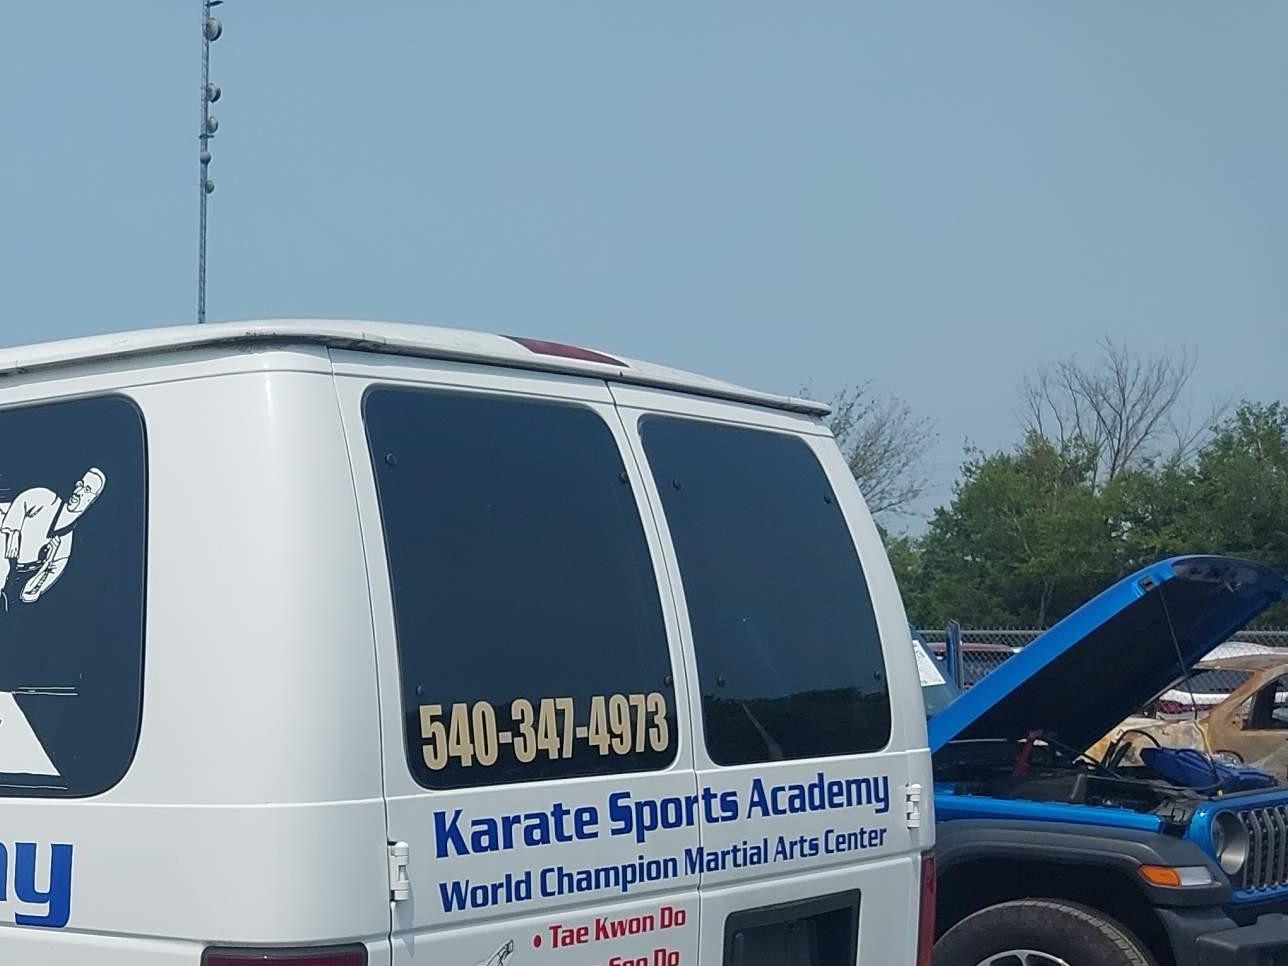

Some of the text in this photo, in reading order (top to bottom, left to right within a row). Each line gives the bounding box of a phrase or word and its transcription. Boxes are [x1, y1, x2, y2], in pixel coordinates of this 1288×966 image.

[418, 692, 669, 771] 540-347-4973
[433, 772, 890, 859] Karate Sports Academy
[439, 826, 888, 913] World Champion Martial Arts Center
[549, 906, 686, 949] Tae Kwon Do
